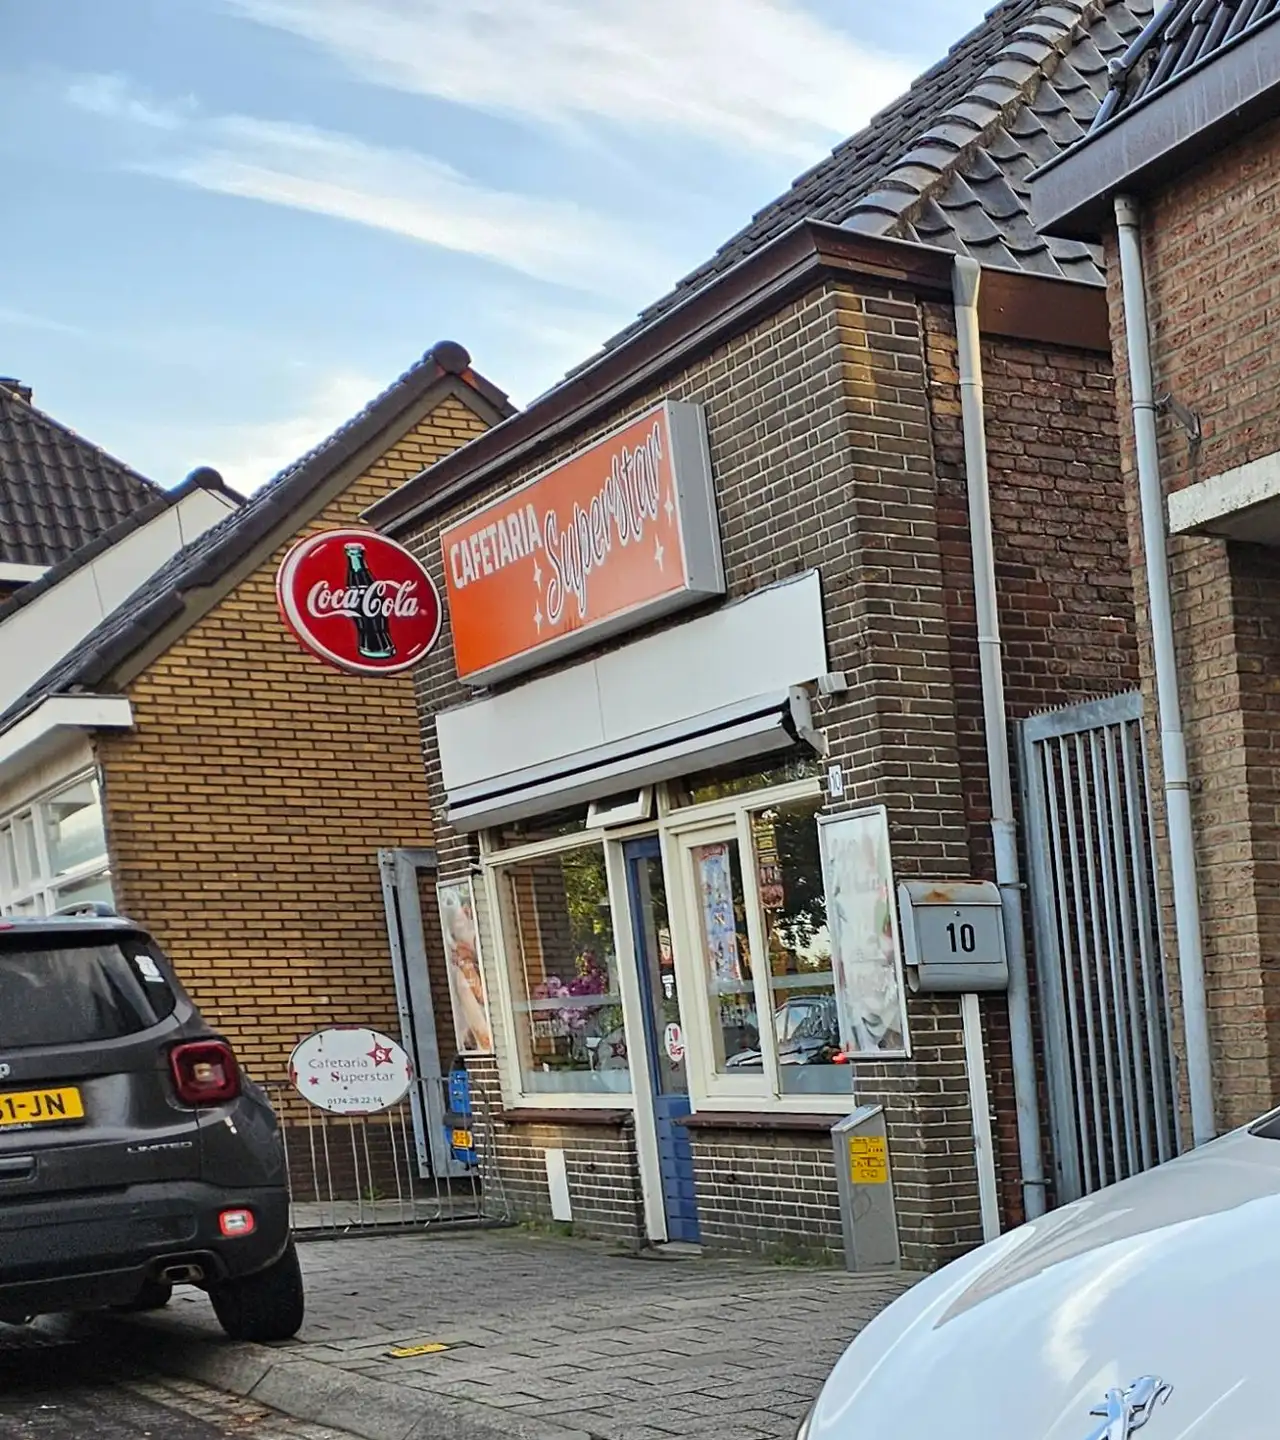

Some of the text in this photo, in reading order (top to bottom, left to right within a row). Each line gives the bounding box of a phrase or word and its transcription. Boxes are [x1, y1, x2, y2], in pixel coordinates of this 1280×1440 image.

[451, 421, 662, 625] CAFETARIA Superstar
[307, 580, 419, 618] Coca-Cola
[946, 923, 976, 953] 10
[308, 1057, 368, 1069] Cafetaria
[331, 1071, 395, 1084] Superstar
